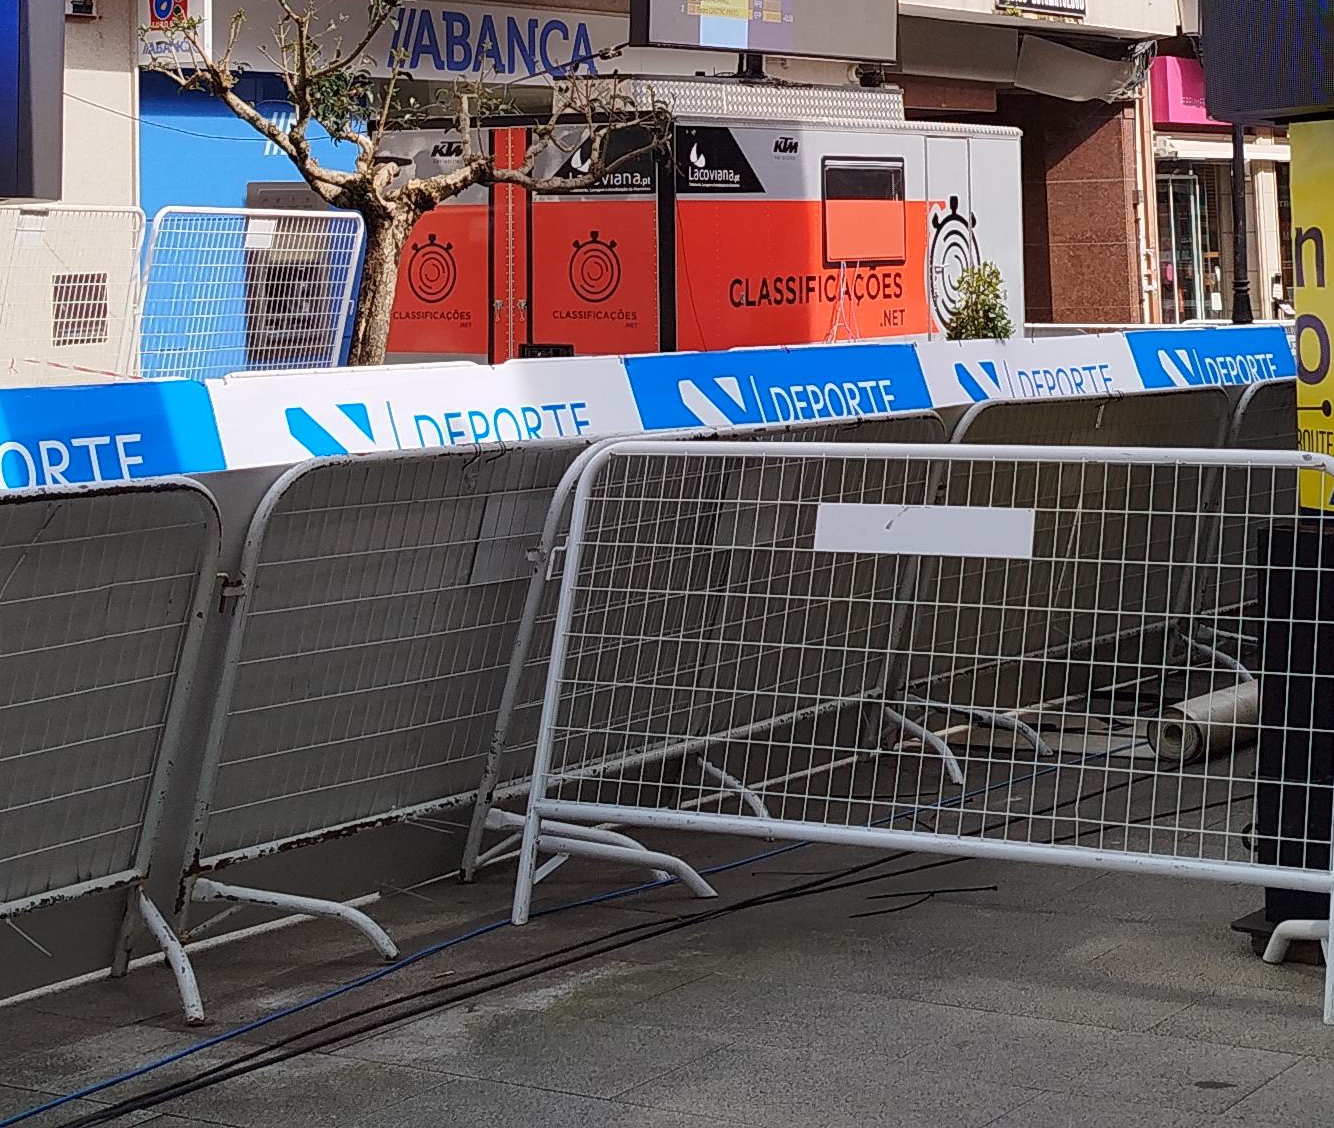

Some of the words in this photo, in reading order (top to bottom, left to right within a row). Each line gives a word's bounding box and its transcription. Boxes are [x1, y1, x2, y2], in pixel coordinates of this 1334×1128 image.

[408, 9, 599, 78] ABANCA
[773, 137, 798, 153] KTM
[392, 309, 471, 321] CLASSIFICAÇÕES
[552, 309, 637, 321] CLASSIFICAÇÕES
[879, 309, 906, 327] .NET
[1018, 363, 1110, 399] DEPORTE
[1205, 353, 1277, 386] DEPORTE
[772, 380, 896, 425] DEPORTE
[414, 402, 590, 447] DEPORTE
